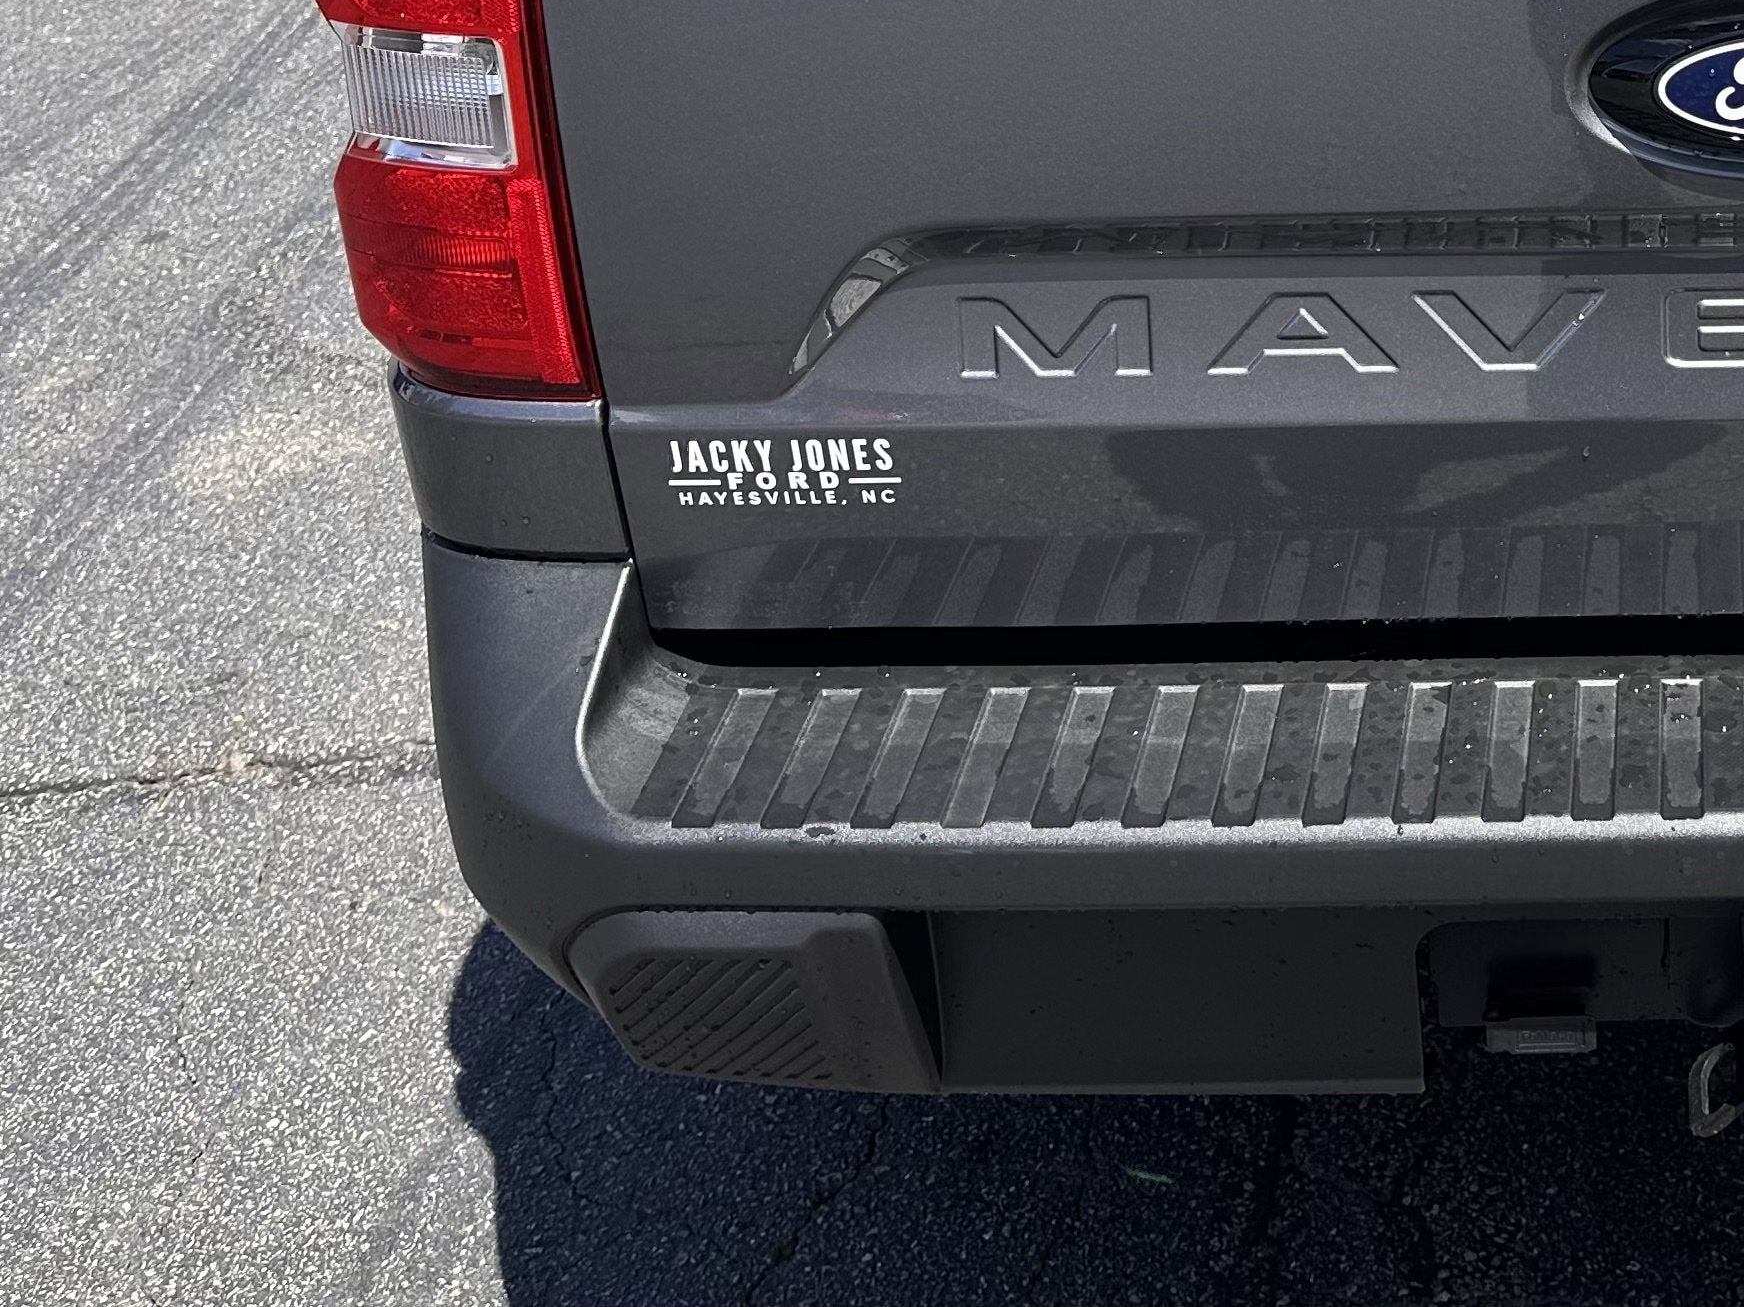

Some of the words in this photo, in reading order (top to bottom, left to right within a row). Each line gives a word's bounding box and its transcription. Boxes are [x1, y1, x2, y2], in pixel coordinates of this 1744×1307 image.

[669, 439, 772, 473] JACKY
[790, 438, 894, 472] JONES
[726, 471, 840, 490] FORD
[678, 490, 848, 506] HAYESVILLE,
[861, 489, 896, 504] NC
